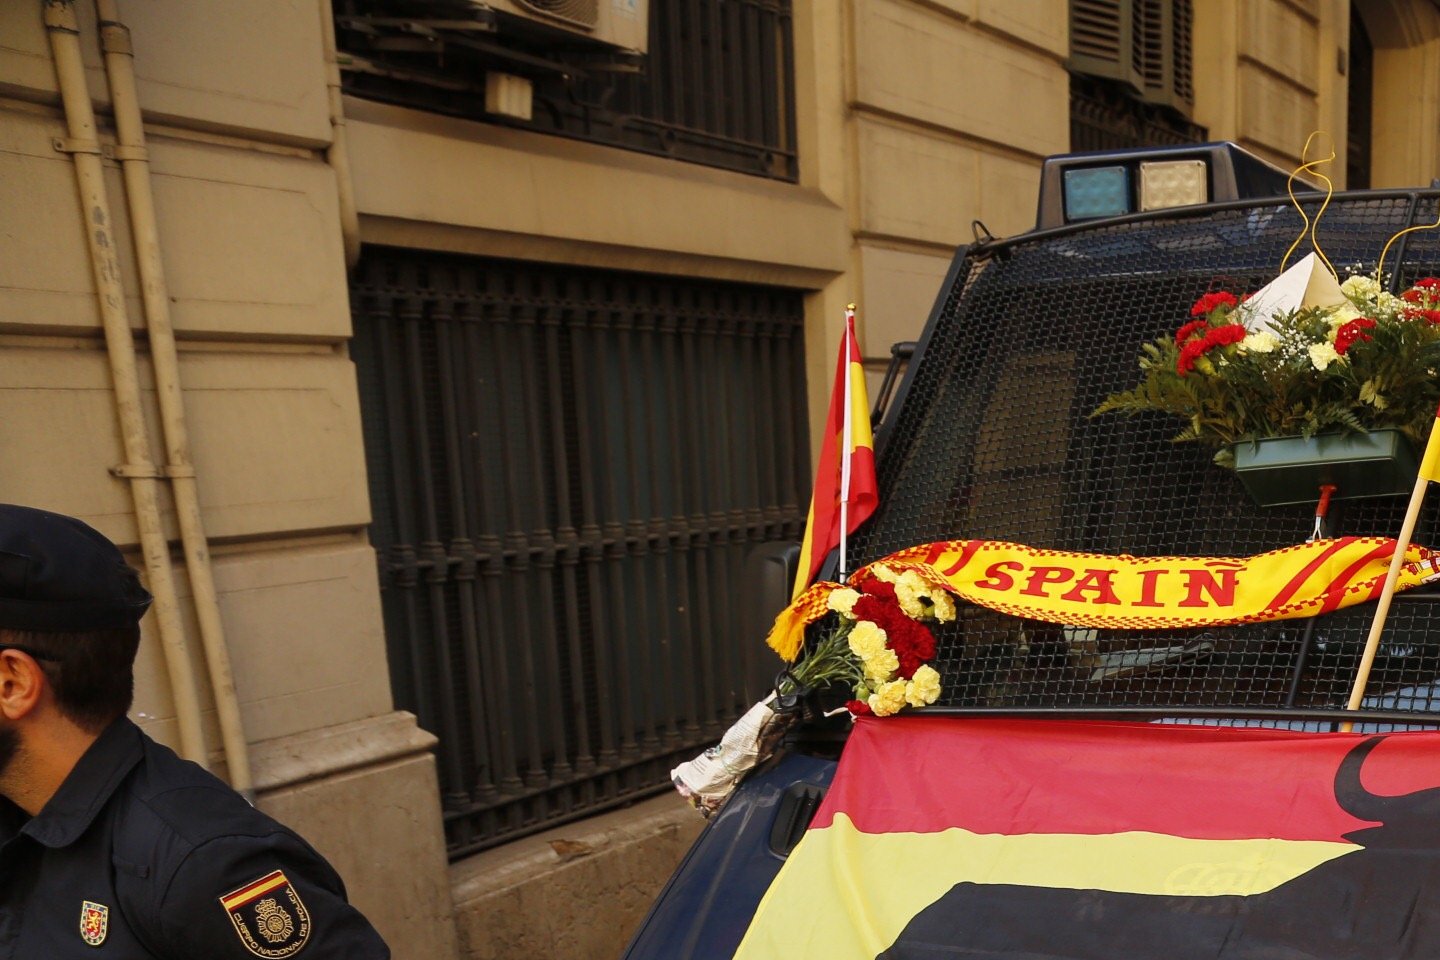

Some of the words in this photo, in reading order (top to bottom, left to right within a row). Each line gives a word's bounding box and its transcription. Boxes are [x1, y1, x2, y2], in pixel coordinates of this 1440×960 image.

[974, 561, 1247, 607] SPAIÑ
[234, 913, 258, 949] CUERPO
[258, 940, 302, 956] NACIONAL
